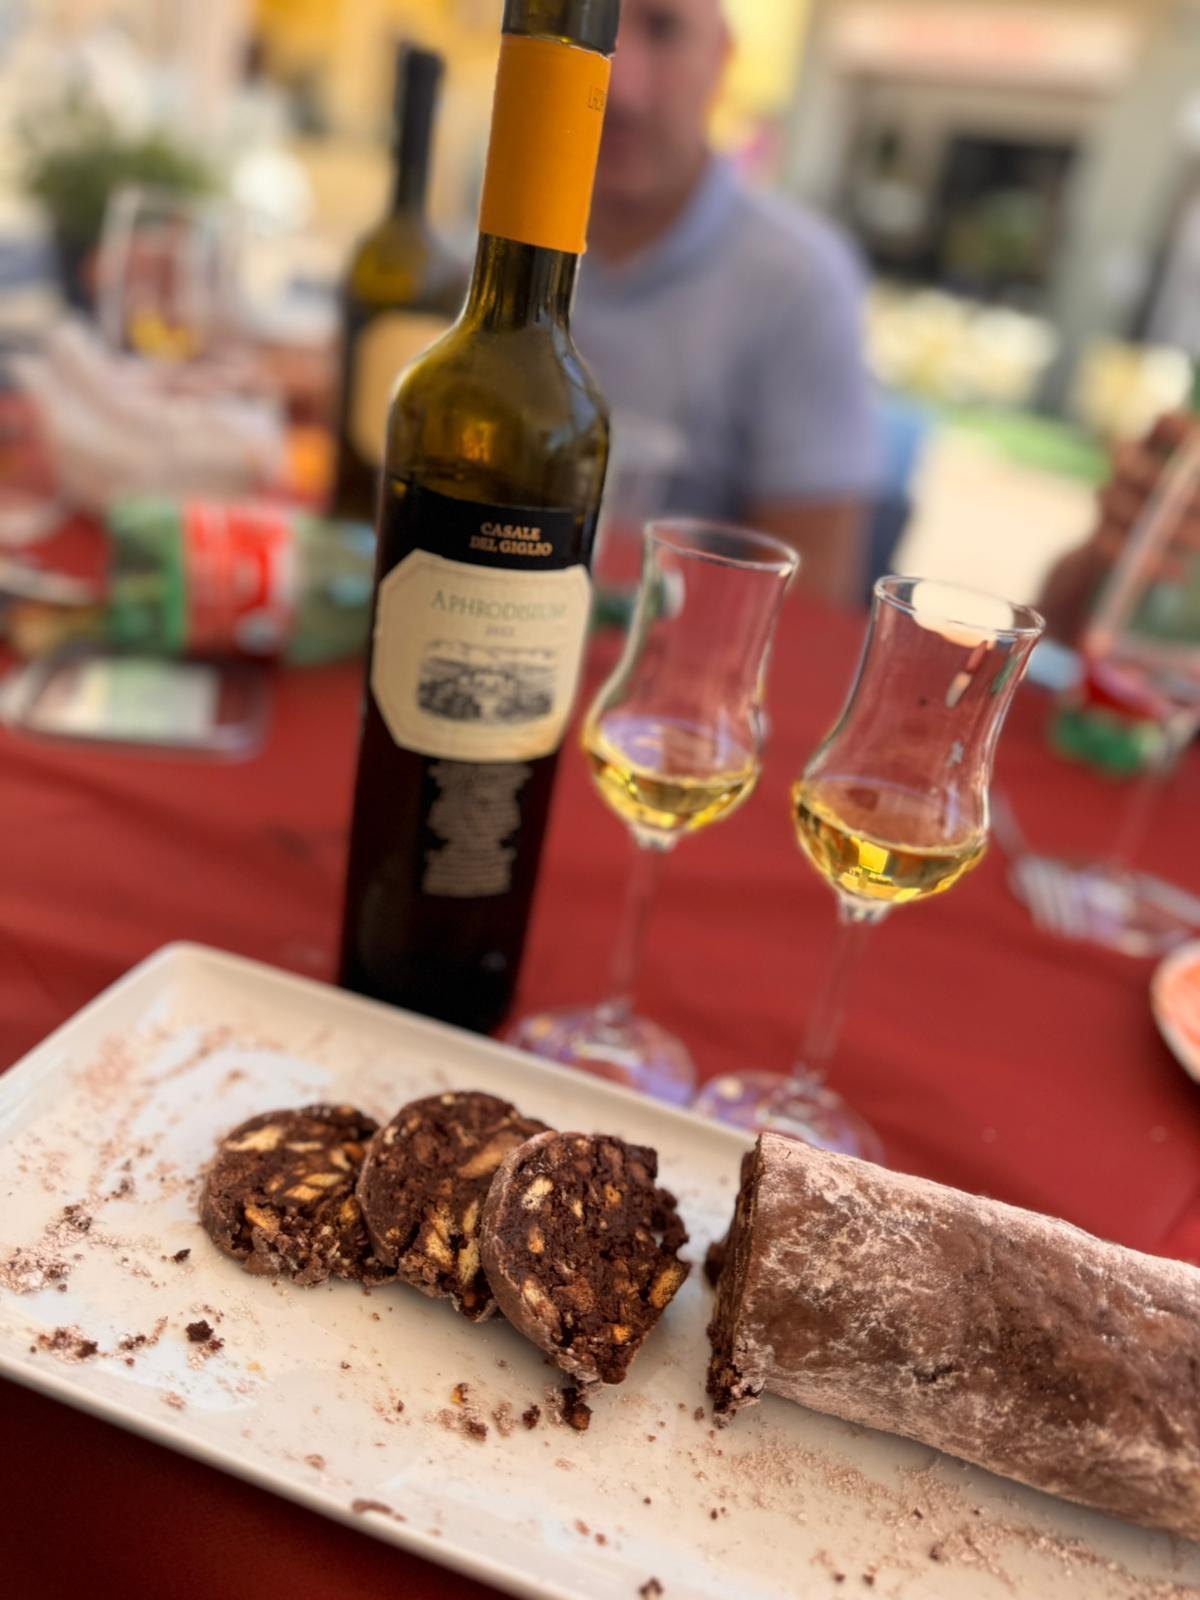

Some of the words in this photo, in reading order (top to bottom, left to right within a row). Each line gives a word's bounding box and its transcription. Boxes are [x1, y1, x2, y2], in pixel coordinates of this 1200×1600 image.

[480, 521, 541, 541] CASALE
[470, 535, 498, 553] DEL
[499, 539, 554, 557] GIGLIO
